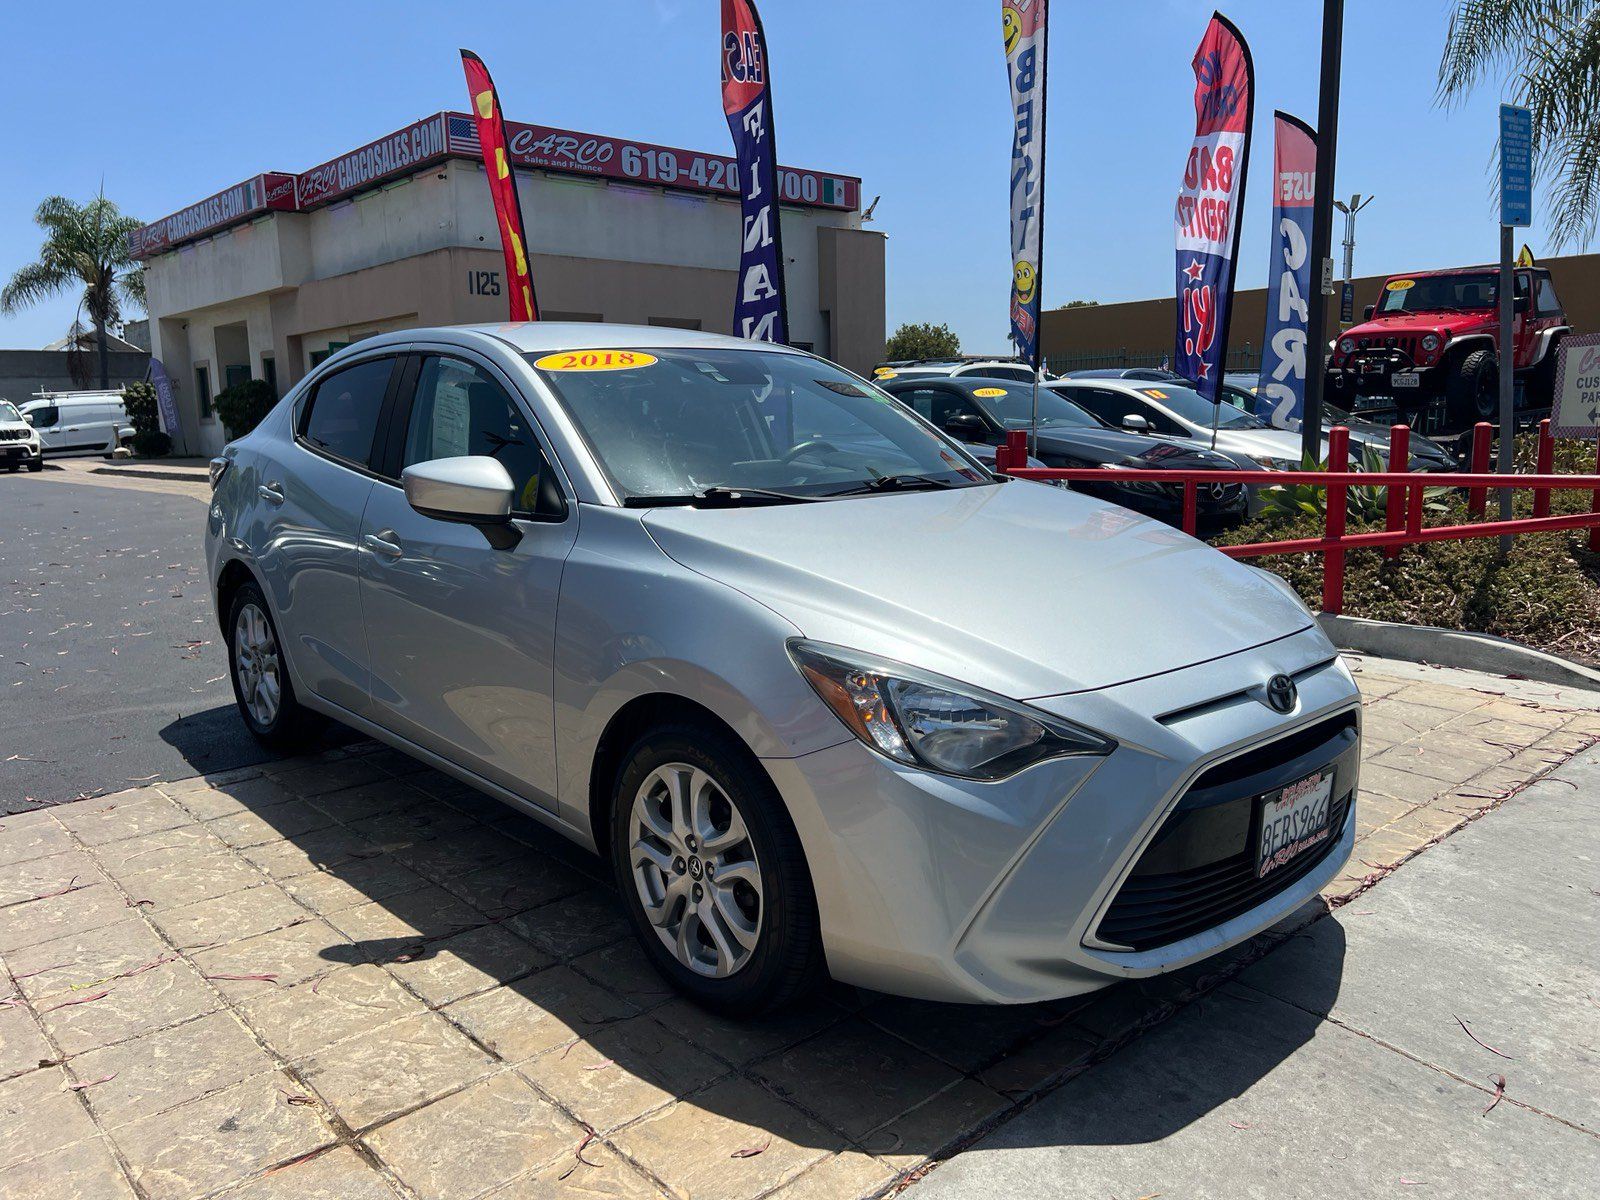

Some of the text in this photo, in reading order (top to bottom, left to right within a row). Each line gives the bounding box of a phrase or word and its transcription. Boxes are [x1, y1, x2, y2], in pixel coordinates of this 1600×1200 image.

[338, 117, 444, 190] CARCOSALES.COM
[511, 129, 613, 165] CARCO
[524, 155, 548, 165] Sales
[569, 161, 602, 172] Finance
[167, 185, 245, 240] CARCOSALES.COM
[468, 271, 500, 296] 1125
[561, 352, 635, 369] 2018
